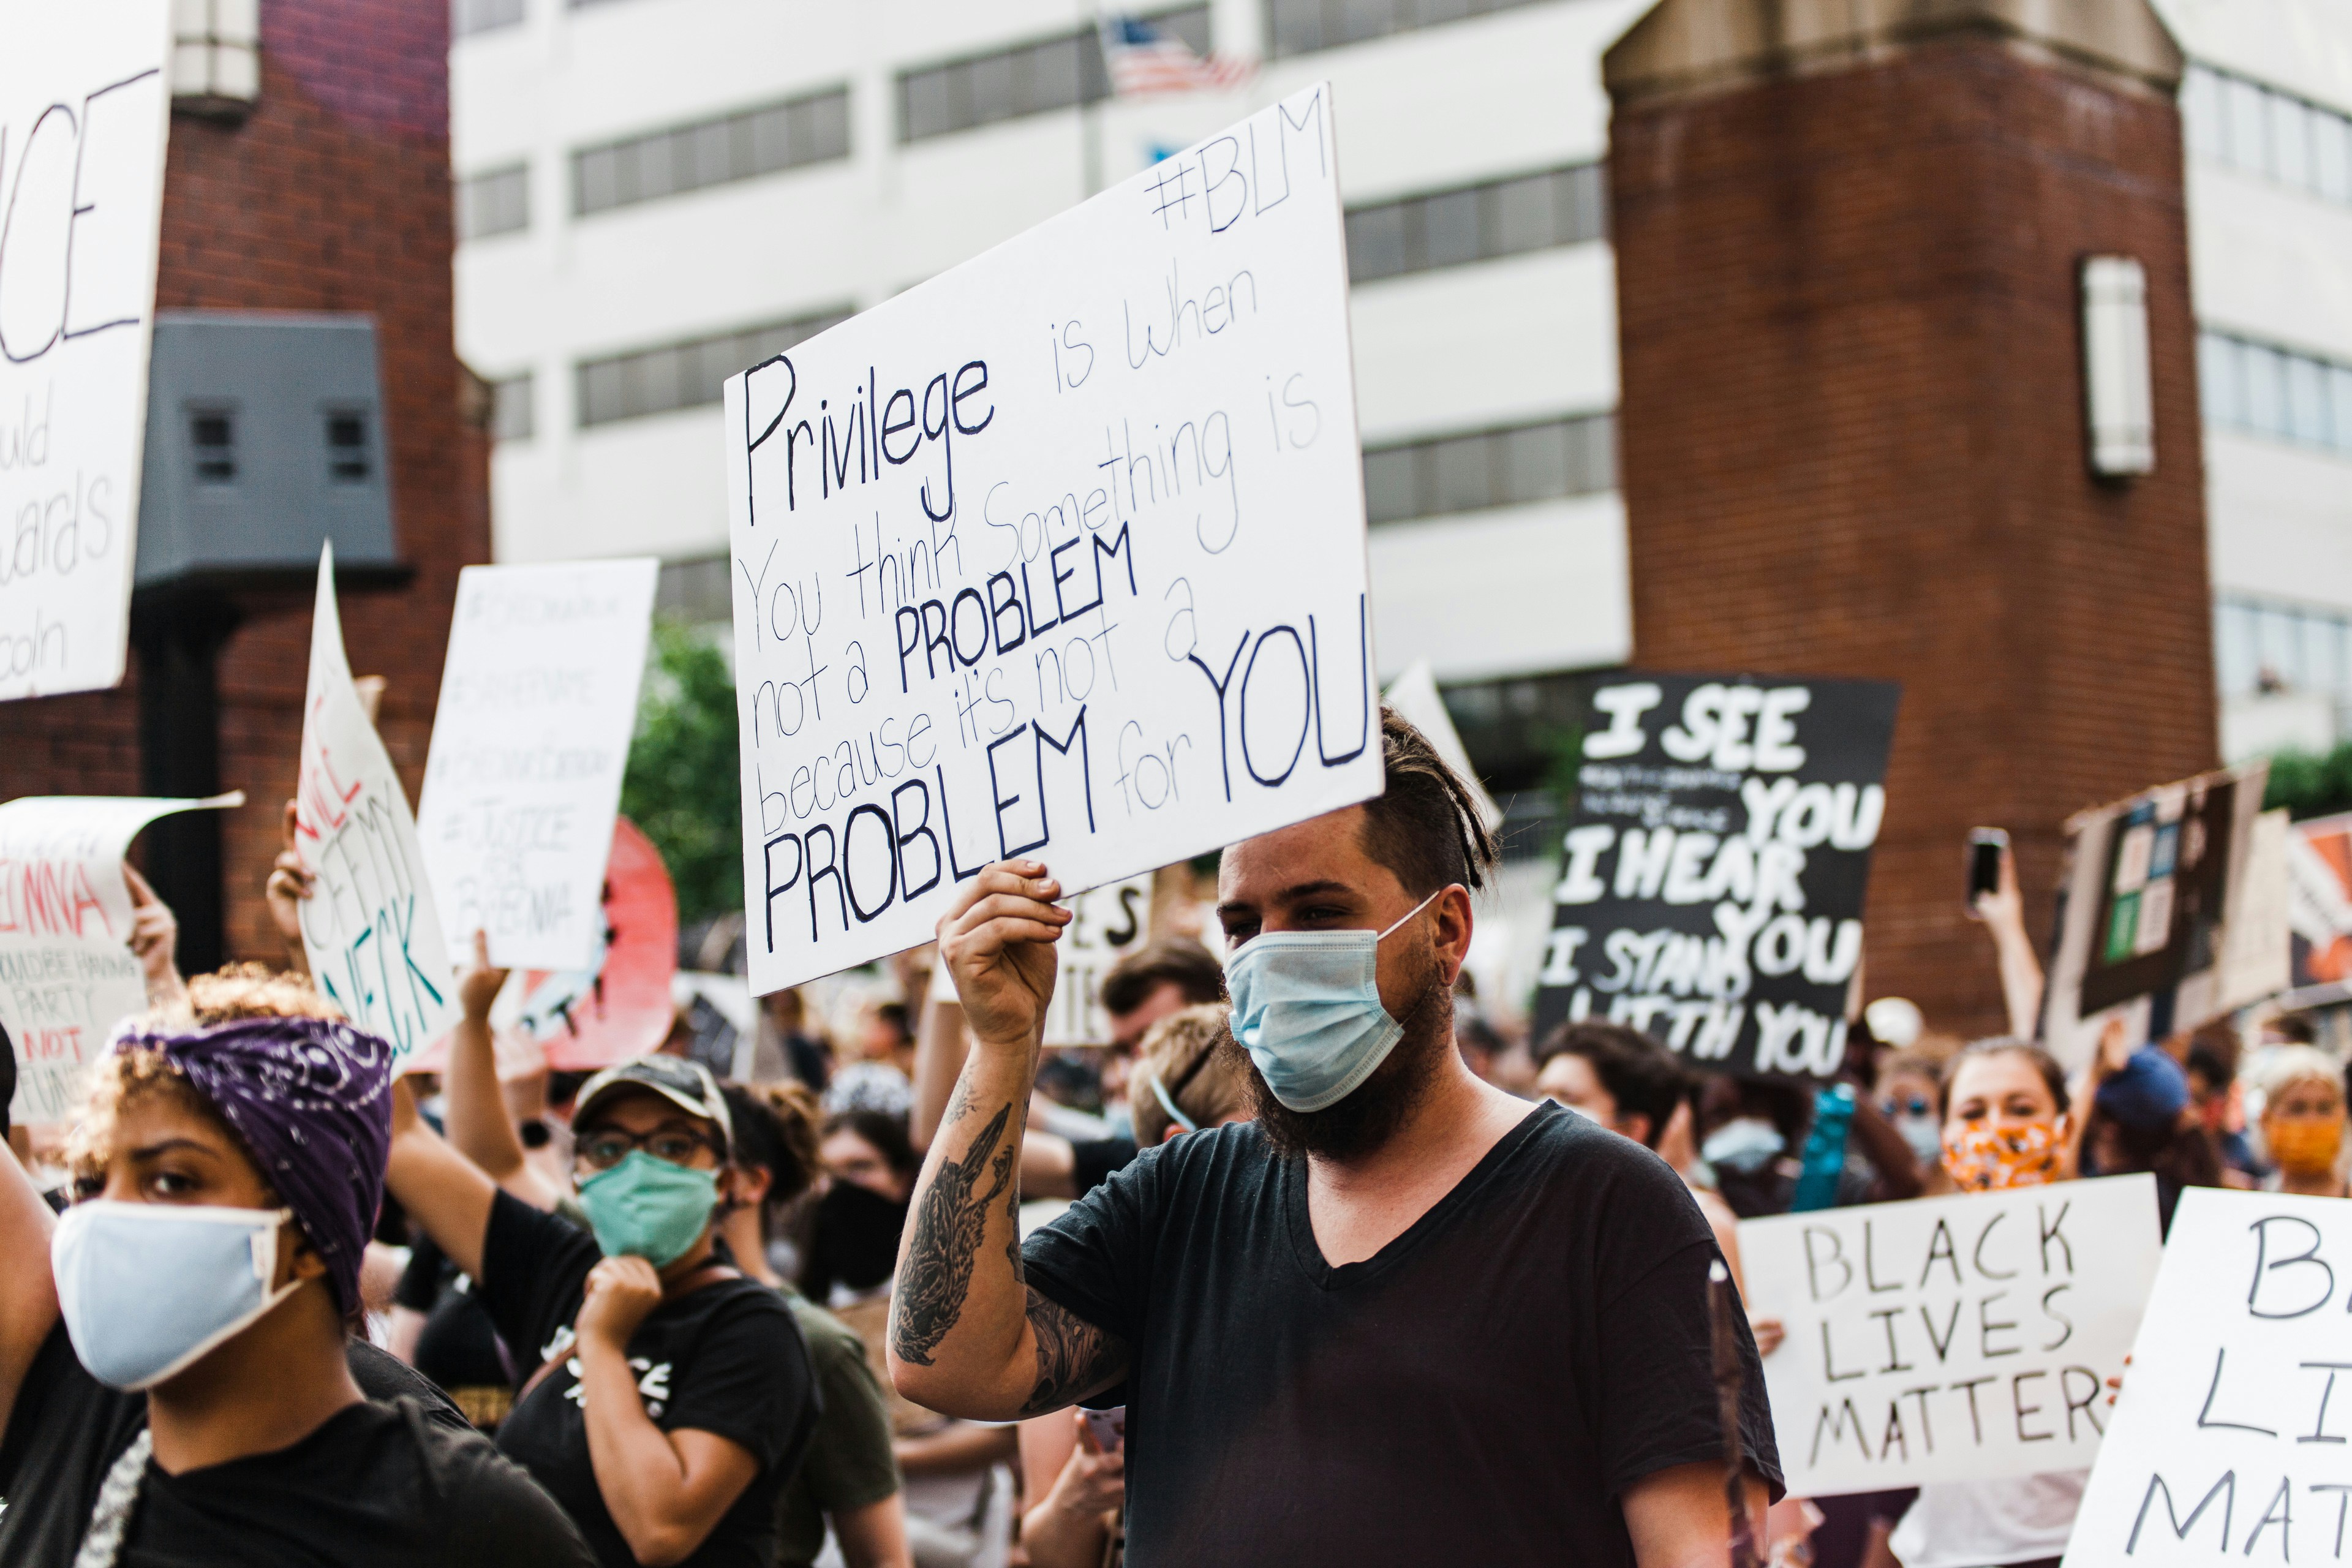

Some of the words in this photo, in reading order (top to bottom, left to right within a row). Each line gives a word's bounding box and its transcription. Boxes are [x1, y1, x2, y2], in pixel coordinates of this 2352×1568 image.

[1144, 88, 1326, 235] #BLM
[0, 69, 159, 363] CE
[745, 353, 995, 527] Privilege
[1051, 320, 1094, 394] is
[738, 538, 821, 653] You
[846, 476, 962, 619] think
[984, 410, 1238, 576] Something
[1265, 372, 1321, 452] is
[753, 636, 828, 748] not
[846, 641, 869, 704] a
[895, 521, 1137, 693] PROBLEM
[756, 714, 937, 837] because
[954, 667, 1015, 748] it's
[1036, 607, 1118, 712] not
[1164, 577, 1197, 662] a
[1582, 682, 1662, 760] I
[1660, 683, 1811, 772] SEE
[764, 704, 1096, 954] PROBLEM
[1114, 720, 1192, 817] for
[1188, 593, 1368, 803] YOU
[1740, 775, 1886, 851] YOU
[1071, 886, 1141, 948] ES
[1554, 824, 1616, 904] I
[1614, 826, 1808, 914] HEAR
[322, 892, 443, 1065] NECK
[1539, 925, 1589, 987] I
[1713, 898, 1864, 985] YOU
[23, 1025, 81, 1065] NOT
[1753, 1000, 1849, 1077] YOU
[1803, 1199, 2076, 1303] BLACK
[2248, 1215, 2352, 1319] B
[1820, 1283, 2074, 1383] LIVES
[1807, 1365, 2105, 1470] MATTER
[2198, 1347, 2352, 1444] LI
[2125, 1469, 2352, 1566] MAT
